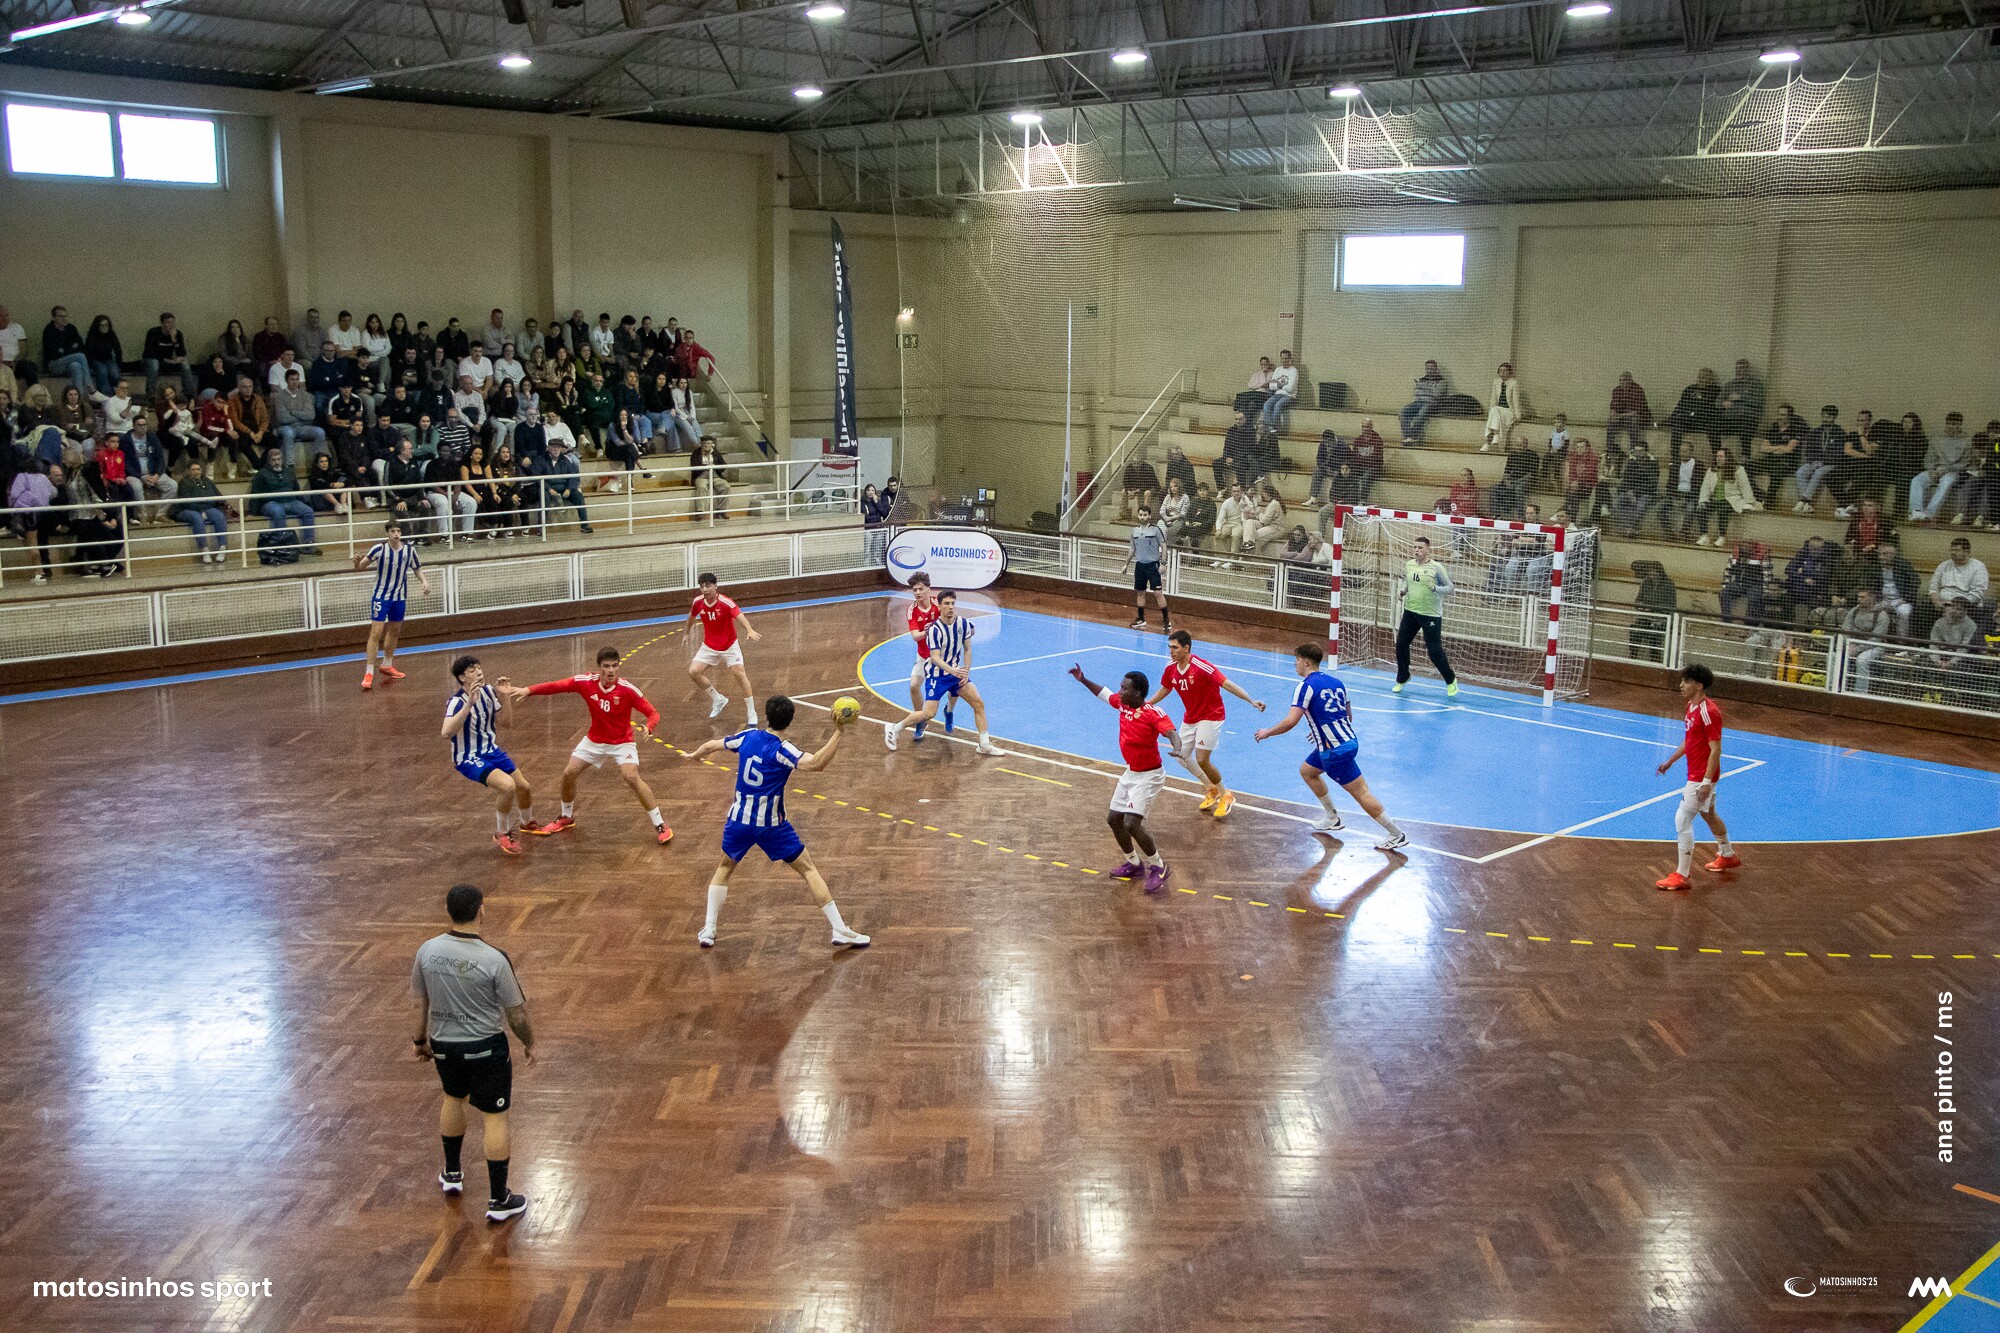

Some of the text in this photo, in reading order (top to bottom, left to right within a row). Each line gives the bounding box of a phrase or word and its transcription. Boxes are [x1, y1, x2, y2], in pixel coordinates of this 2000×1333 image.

[1412, 572, 1421, 582] 16
[373, 601, 382, 612] 15
[707, 611, 716, 621] 14
[930, 678, 937, 689] 4
[1178, 679, 1189, 691] 21
[599, 698, 611, 712] 18
[743, 754, 764, 787] 6
